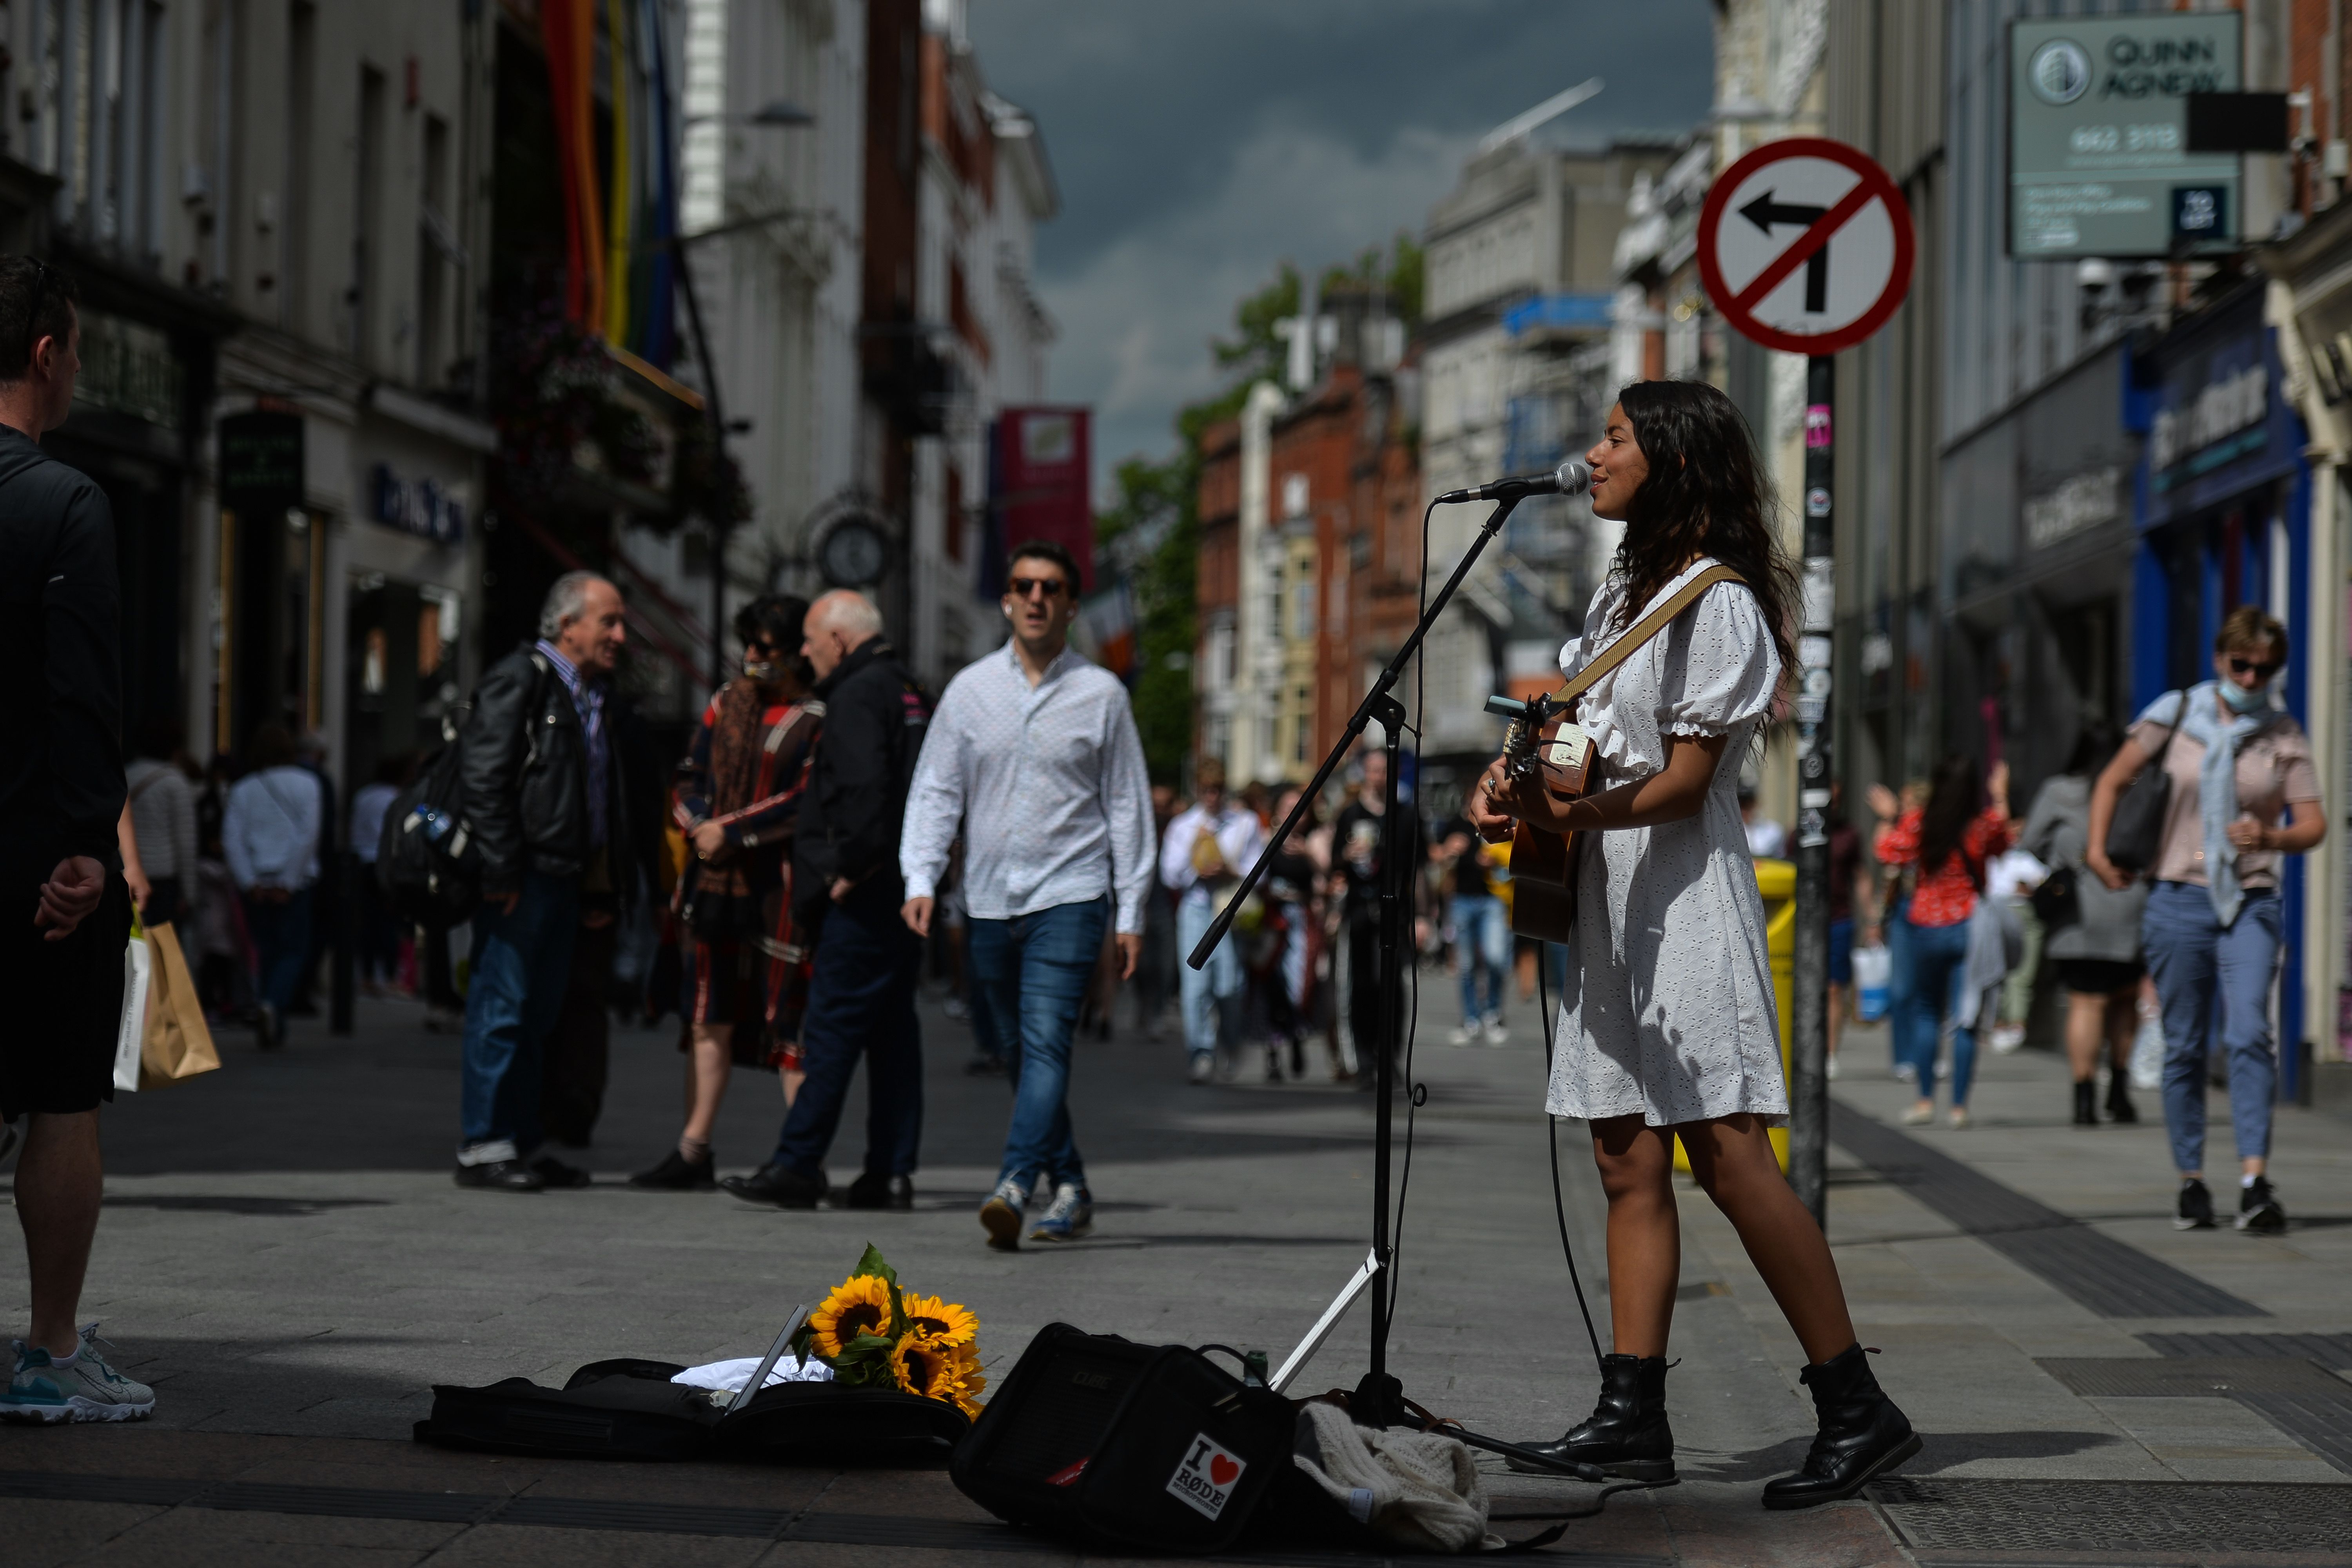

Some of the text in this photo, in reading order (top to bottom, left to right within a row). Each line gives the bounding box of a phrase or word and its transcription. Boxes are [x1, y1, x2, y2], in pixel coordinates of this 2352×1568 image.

[2105, 33, 2216, 67] QUINN
[2099, 72, 2223, 99] AGNEW
[1073, 1371, 1112, 1390] CUBE
[1185, 1440, 1212, 1472] I
[1172, 1481, 1218, 1514] MICROPHONES
[1176, 1467, 1225, 1508] RØDE
